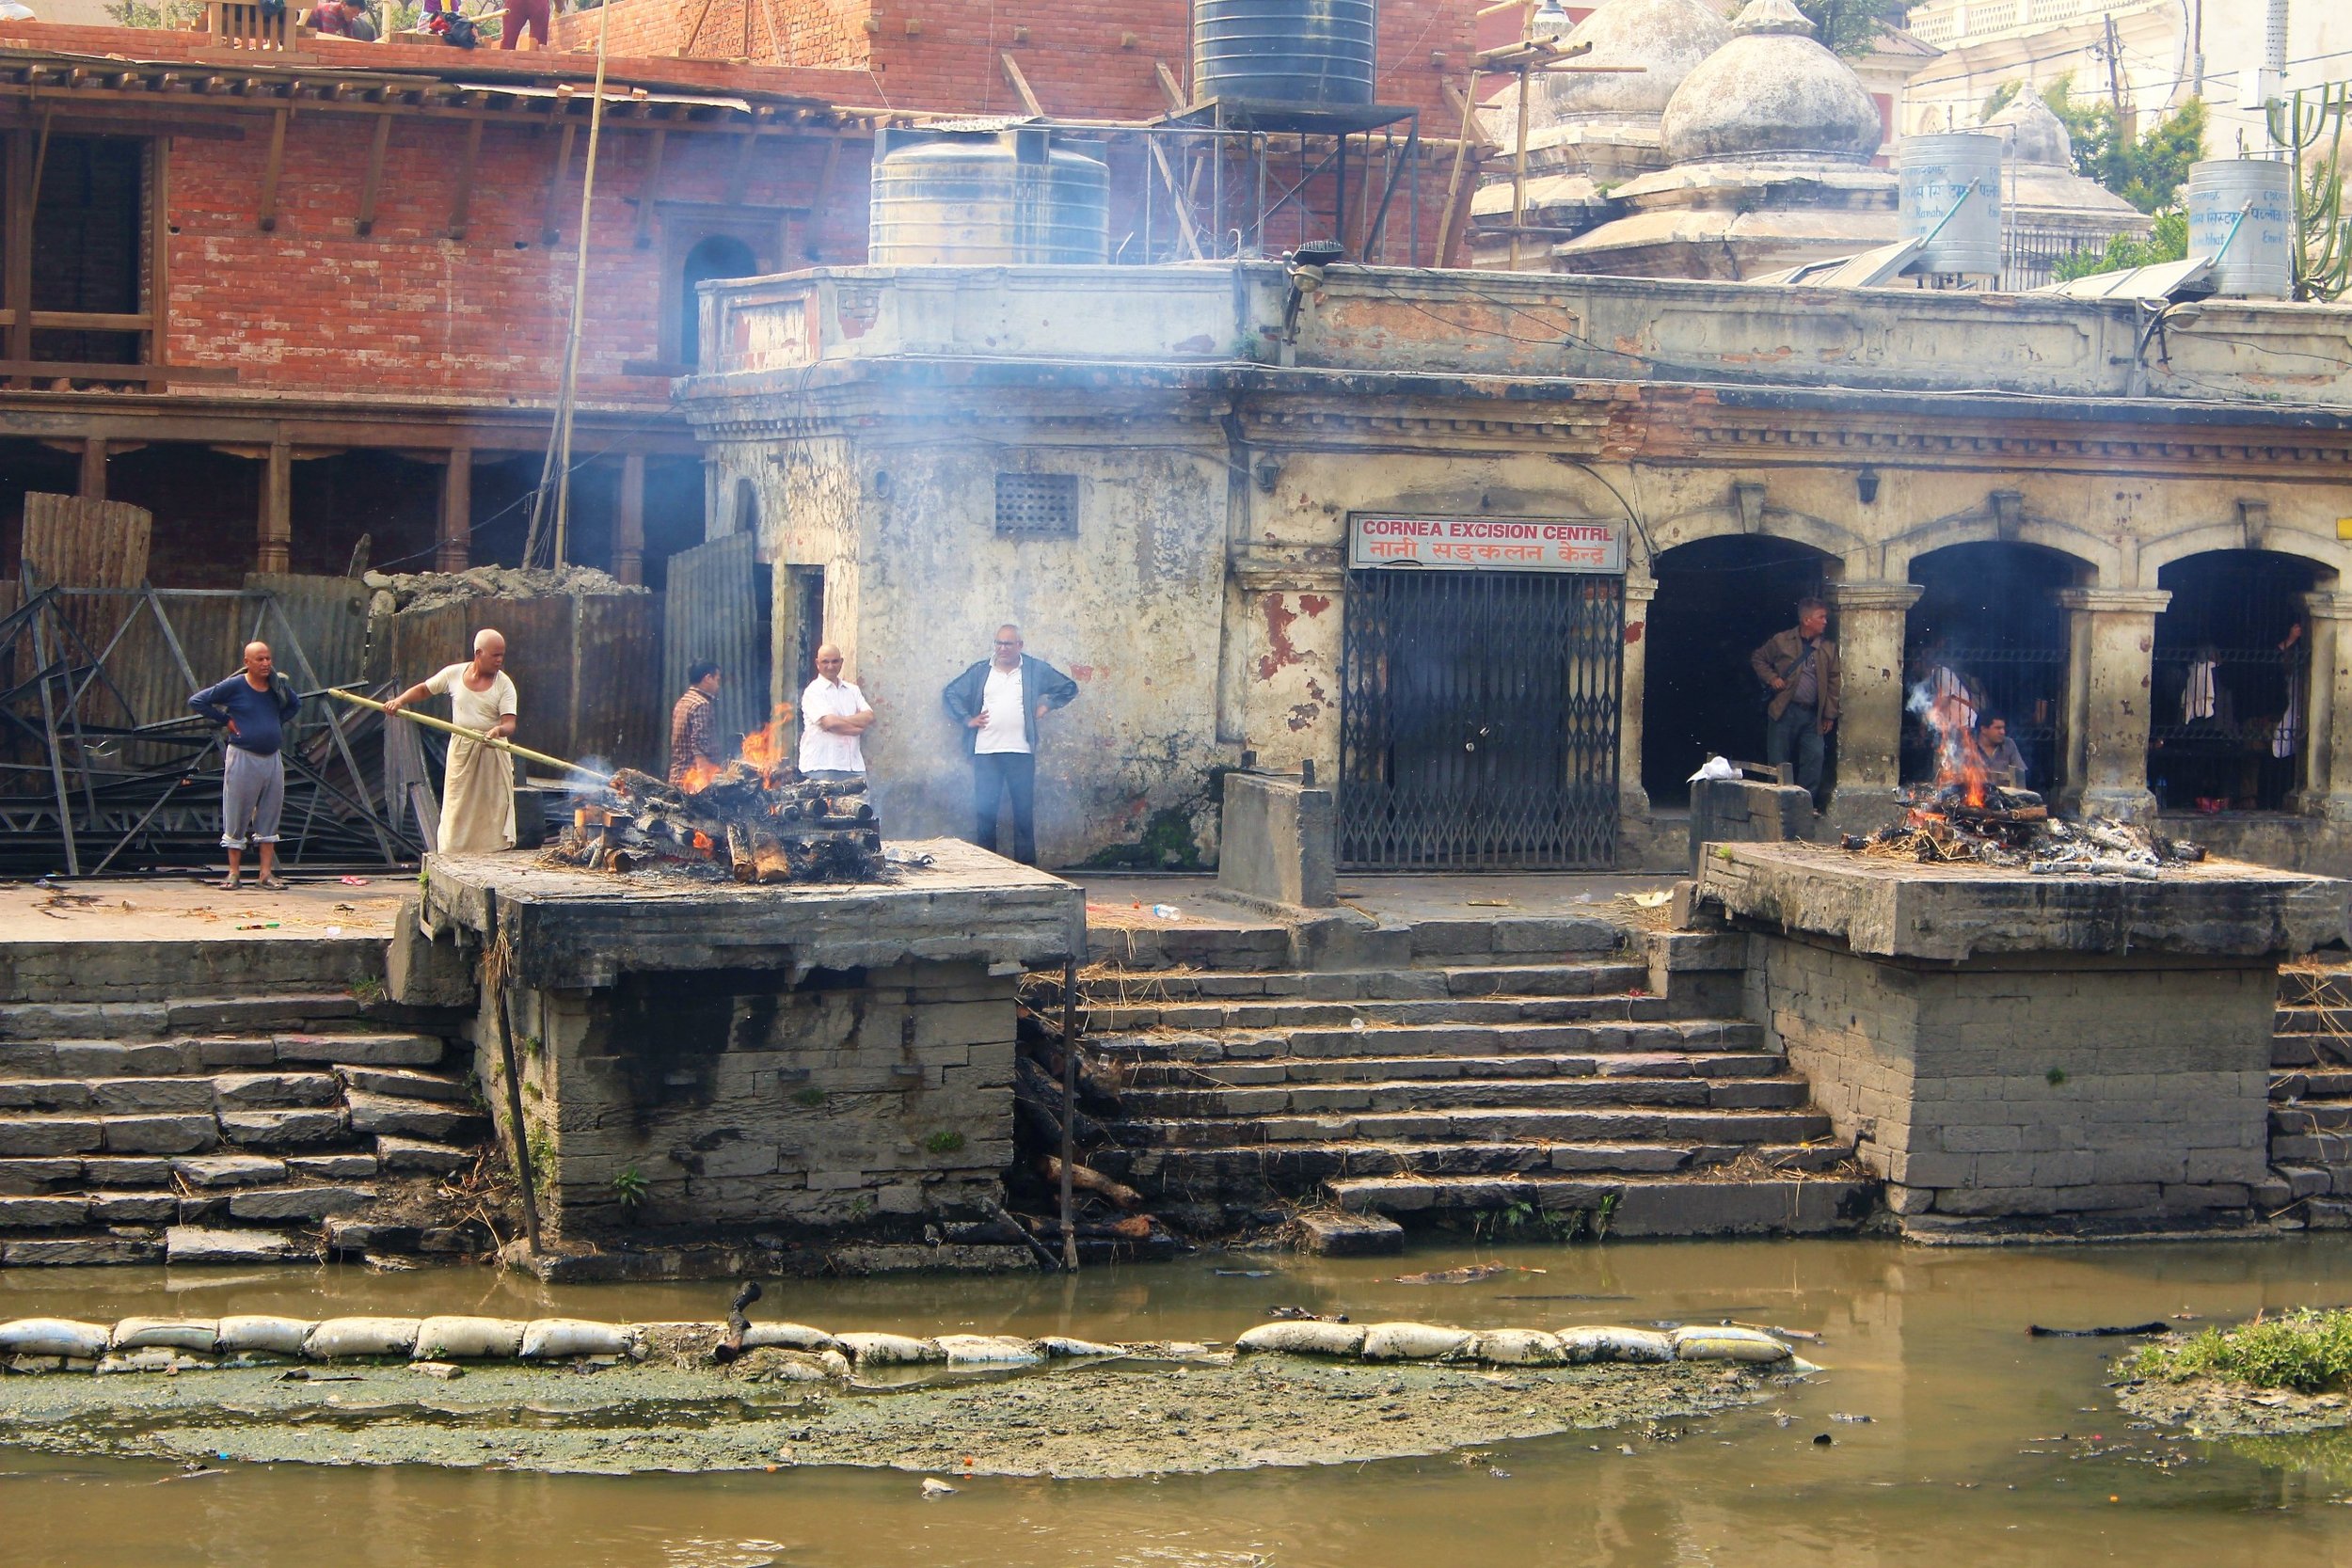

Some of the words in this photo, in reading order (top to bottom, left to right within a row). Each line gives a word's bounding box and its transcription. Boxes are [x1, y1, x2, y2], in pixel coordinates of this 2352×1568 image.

[1362, 520, 1442, 537] CORNEA
[1449, 523, 1538, 540] EXCISION
[1370, 536, 1419, 558] नानी
[1558, 541, 1606, 565] केन्द्र
